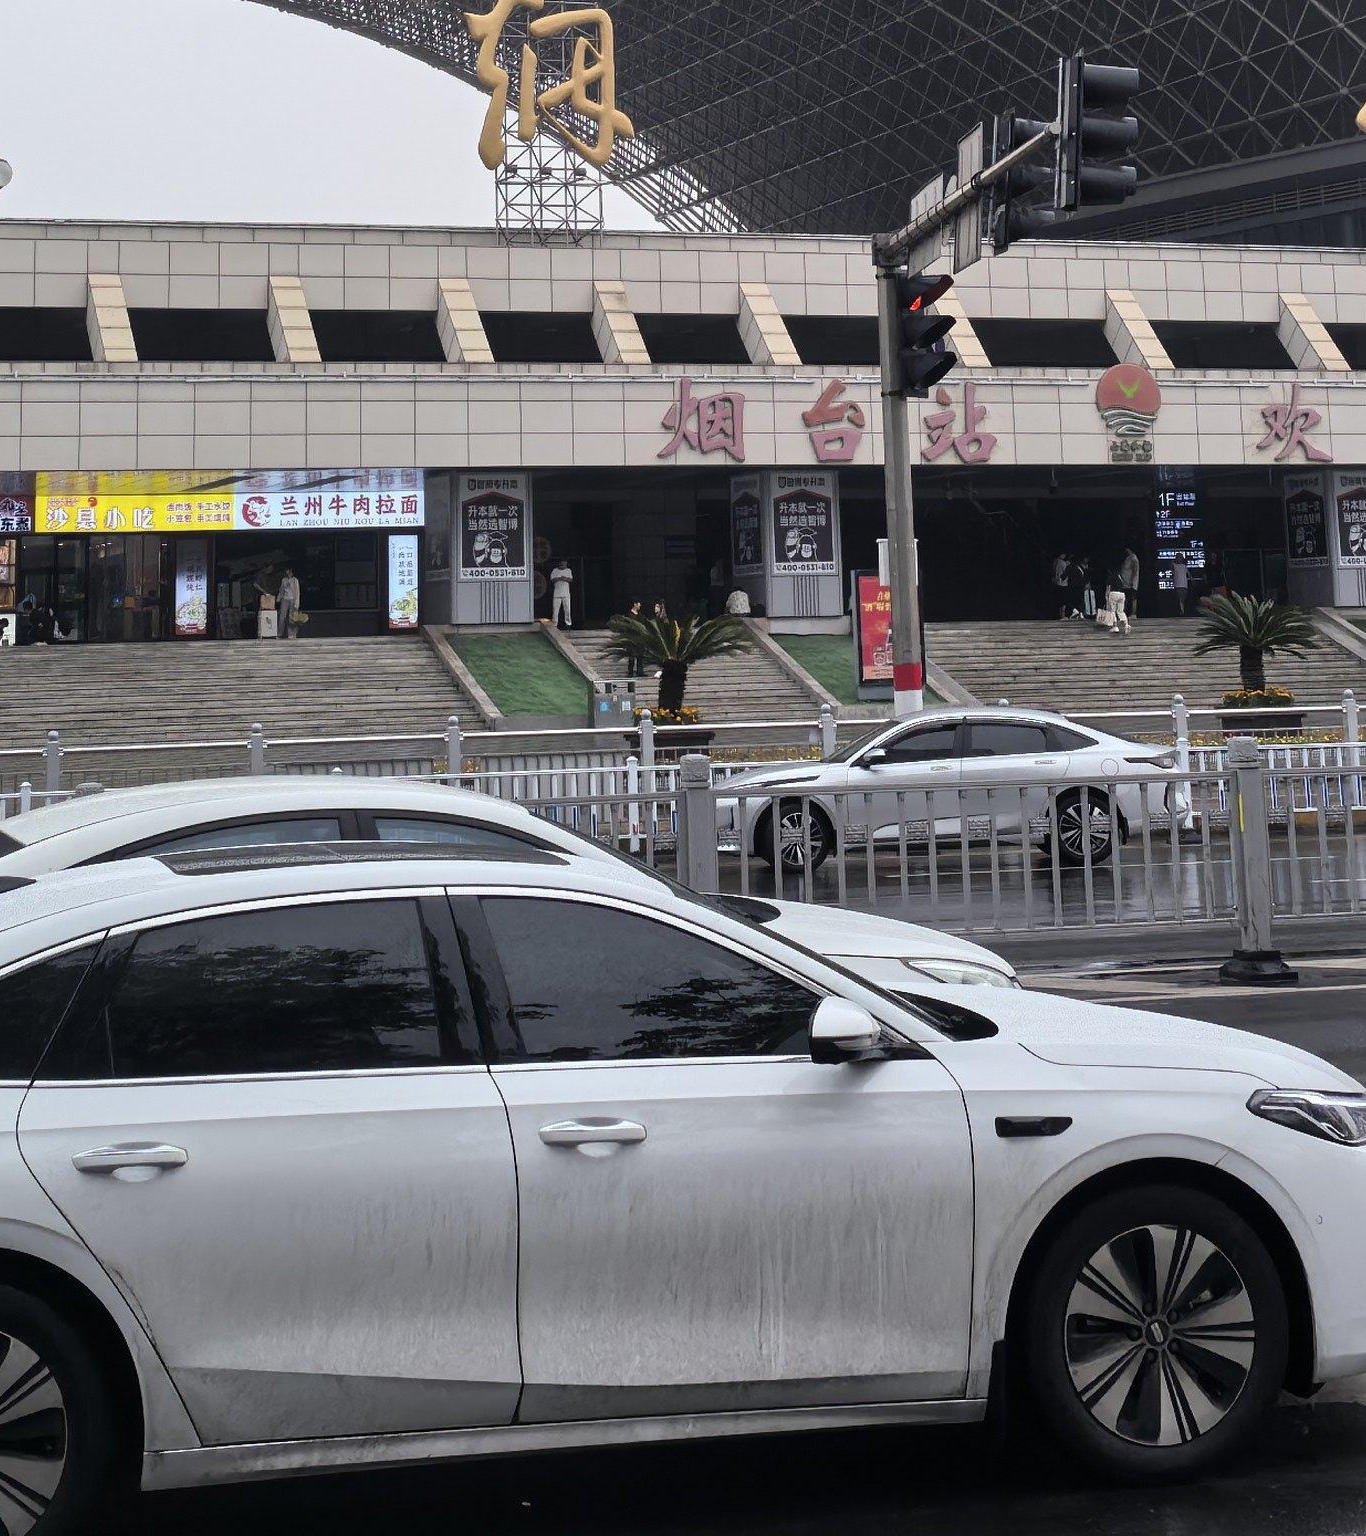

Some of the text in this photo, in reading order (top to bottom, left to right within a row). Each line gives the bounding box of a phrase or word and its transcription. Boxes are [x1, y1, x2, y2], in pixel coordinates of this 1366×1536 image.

[657, 378, 998, 464] 烟台站
[280, 494, 419, 516] 兰州牛肉拉面
[1158, 492, 1175, 506] 1F
[46, 506, 155, 531] 沙县小吃
